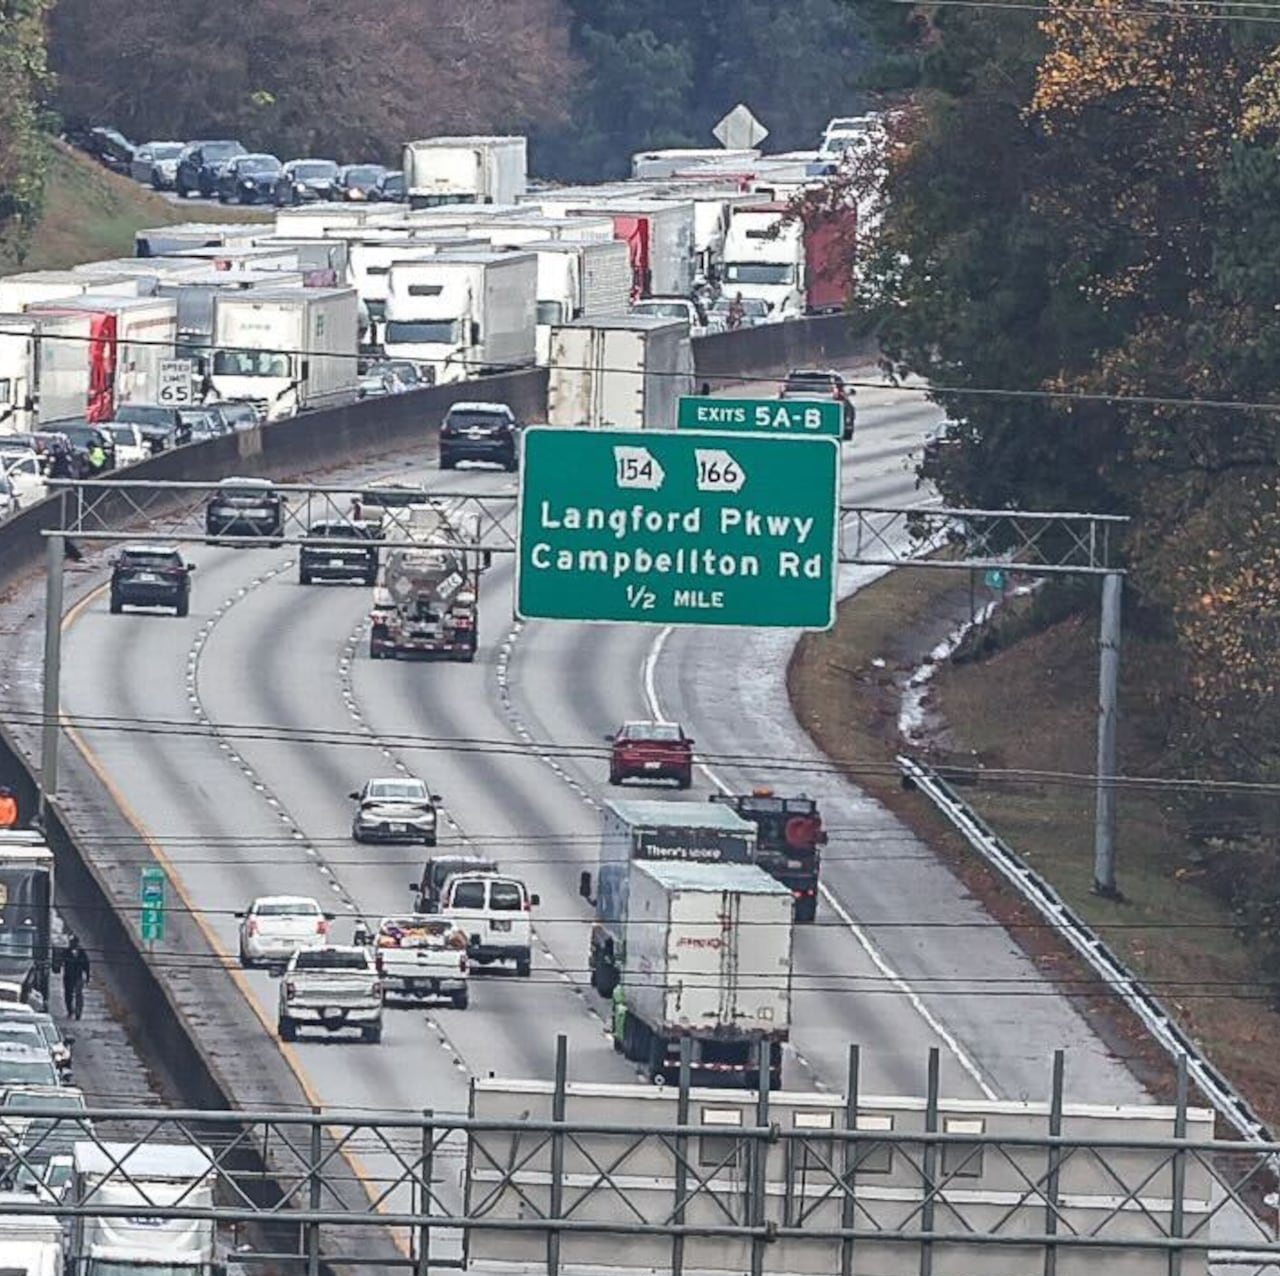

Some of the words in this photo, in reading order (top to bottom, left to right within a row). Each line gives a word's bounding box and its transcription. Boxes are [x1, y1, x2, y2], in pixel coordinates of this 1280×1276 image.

[161, 386, 188, 401] 65
[697, 406, 746, 423] EXITS
[754, 406, 822, 430] 5A-B
[619, 457, 653, 482] 154
[699, 459, 738, 484] 166
[540, 501, 701, 538] Langford
[721, 507, 814, 543] Pkwy
[531, 543, 759, 579] Campbellton
[778, 551, 822, 578] Rd
[674, 589, 724, 609] MILE
